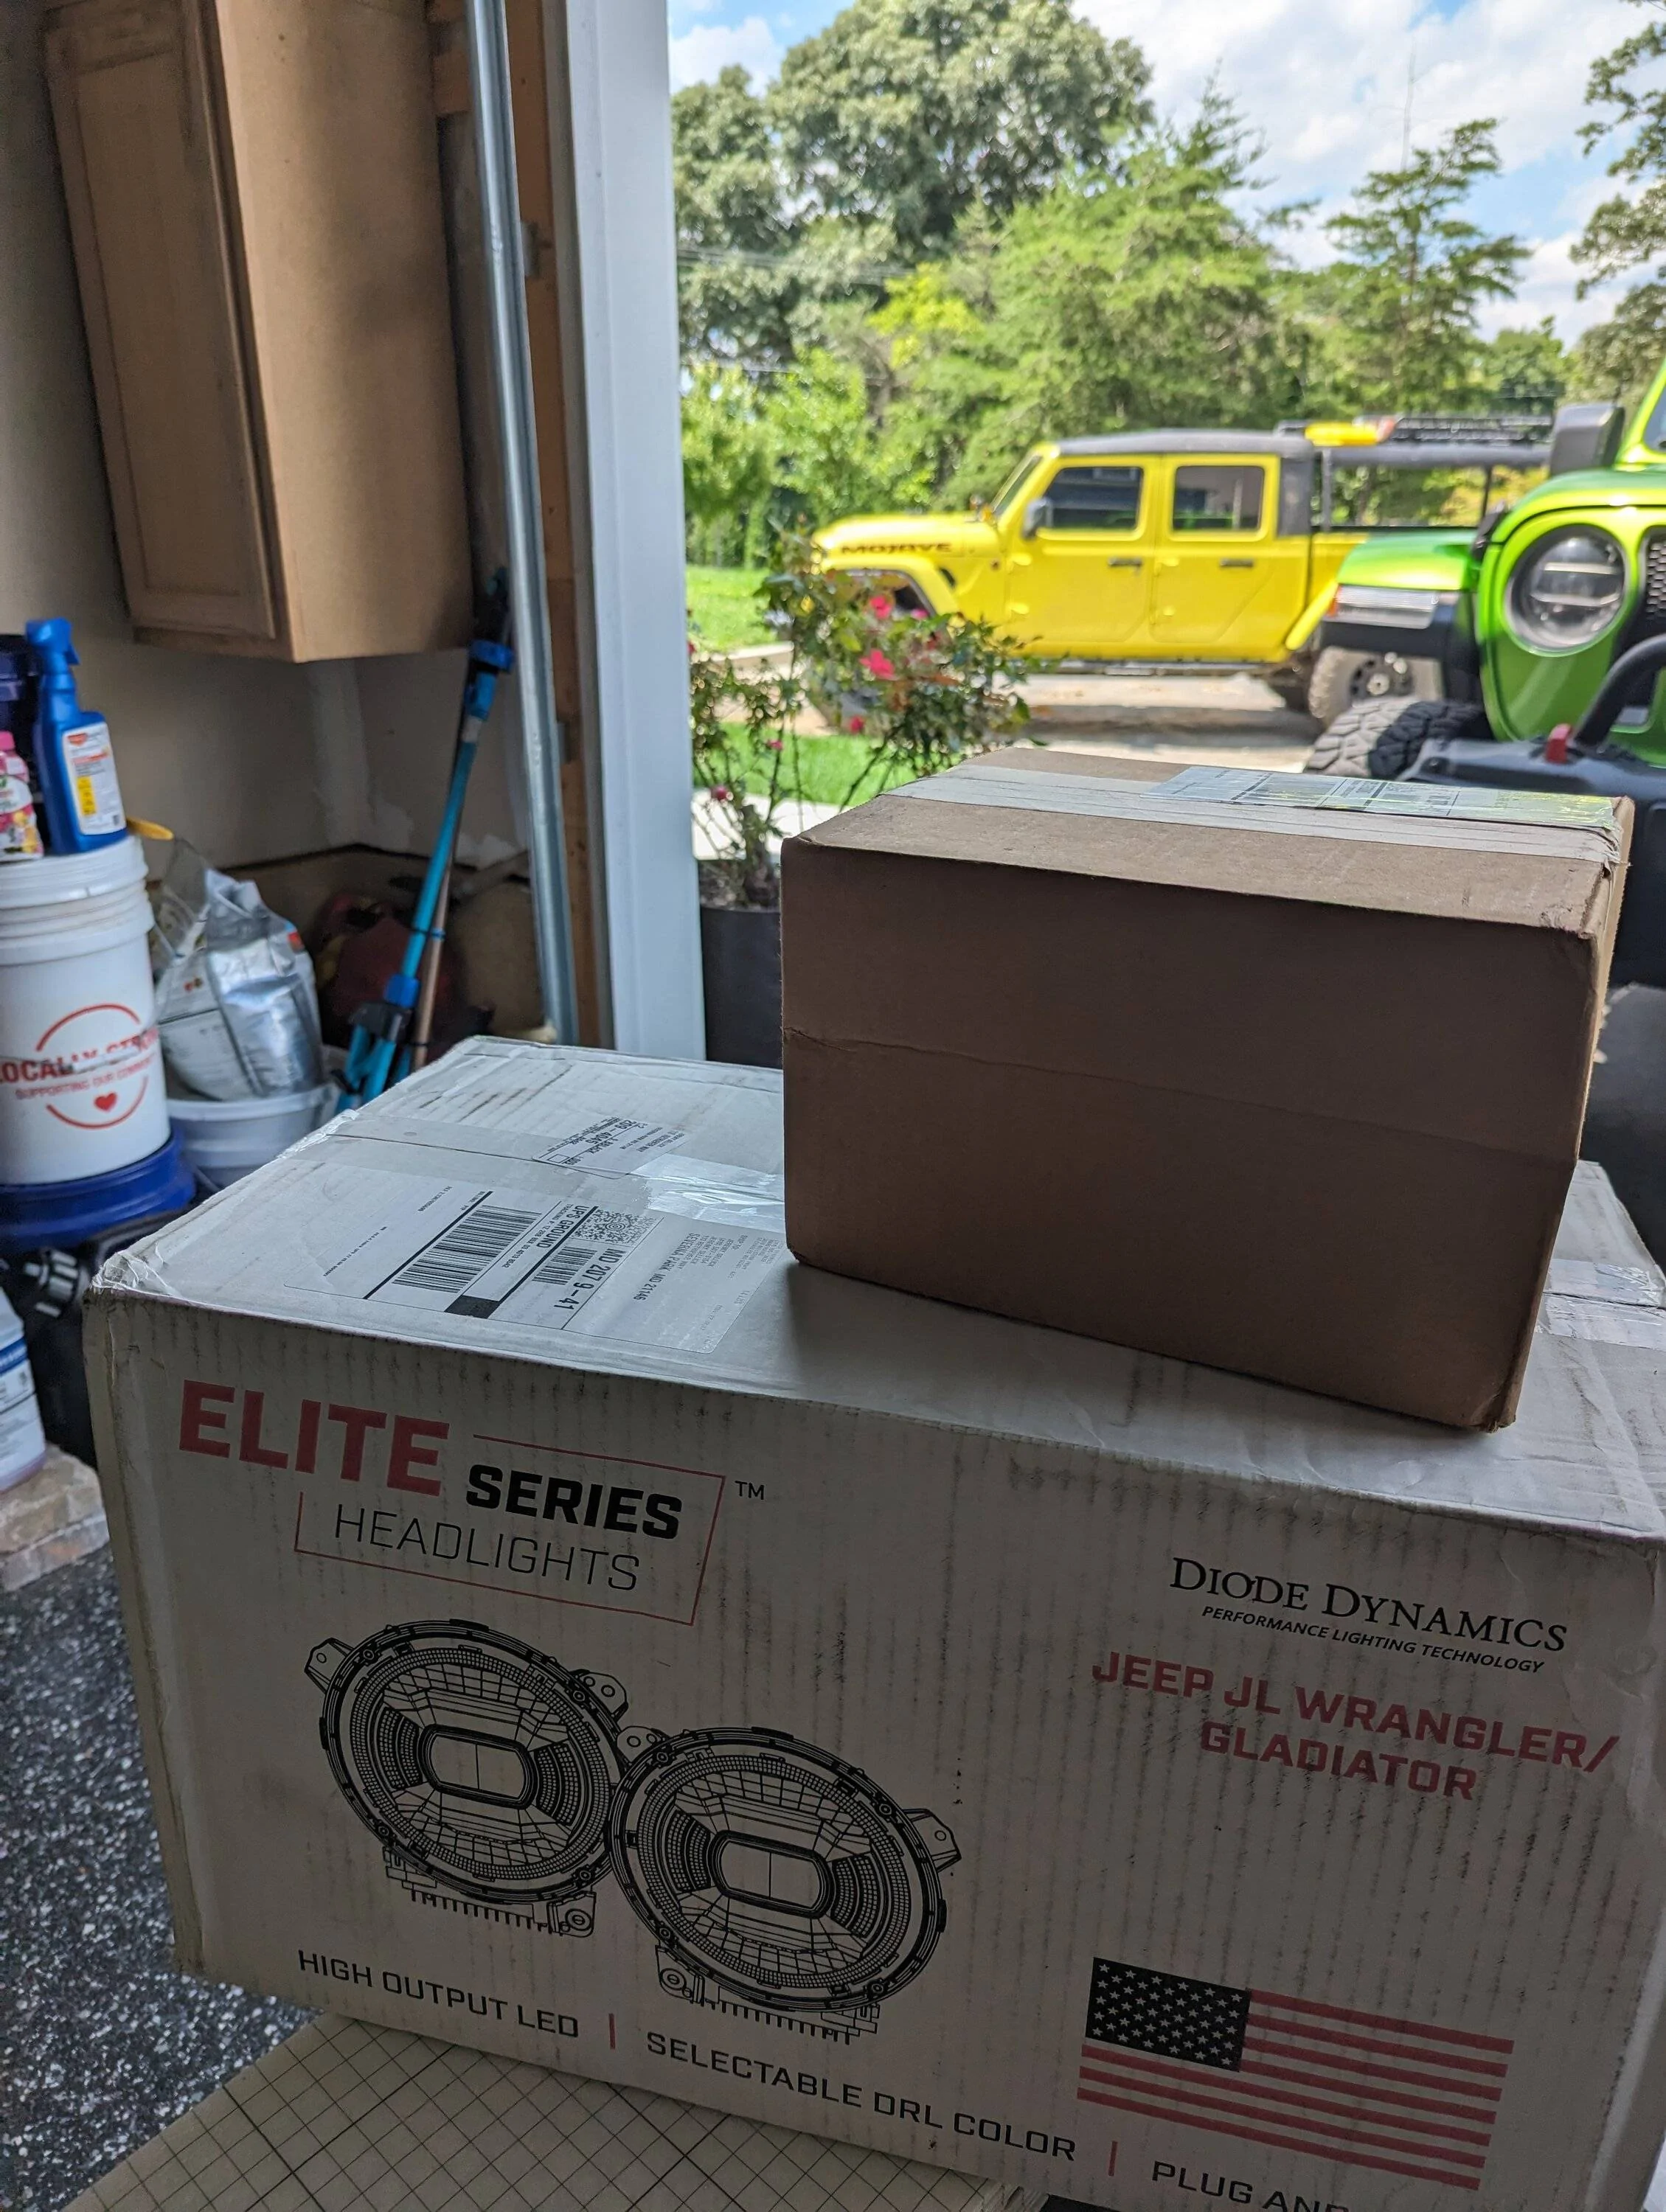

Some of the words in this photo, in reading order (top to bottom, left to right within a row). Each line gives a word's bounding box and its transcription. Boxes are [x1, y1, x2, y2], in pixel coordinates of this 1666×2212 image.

[841, 543, 951, 554] MOJAVE
[564, 1205, 591, 1219] UPS
[534, 1219, 575, 1248] GROUND
[670, 1232, 701, 1256] SEVERNA
[596, 1248, 627, 1263] MD
[657, 1256, 680, 1271] PARK
[578, 1264, 612, 1281] 207
[648, 1273, 666, 1283] MD
[632, 1283, 657, 1301] 21146
[179, 1380, 450, 1497] ELITE
[466, 1464, 683, 1540] SERIES
[336, 1504, 640, 1591] HEADLIGHTS
[1170, 1557, 1310, 1611] DIODE
[1322, 1582, 1568, 1652] DYNAMICS
[1201, 1606, 1329, 1639] PERFORMANCE
[1331, 1628, 1417, 1655] LIGHTING
[1421, 1644, 1546, 1674] TECHNOLOGY
[1091, 1652, 1215, 1697] JEEP
[1223, 1675, 1281, 1716] JL
[1294, 1686, 1620, 1774] WRANGLER/
[1200, 1721, 1477, 1801] GLADIATOR
[299, 1950, 373, 1988] HIGH
[382, 1971, 508, 2021] OUTPUT
[517, 2004, 580, 2039] LED
[646, 2031, 863, 2109] SELECTABLE
[873, 2090, 943, 2130] DRL
[953, 2112, 1076, 2162] COLOR
[1151, 2160, 1254, 2205] PLUG
